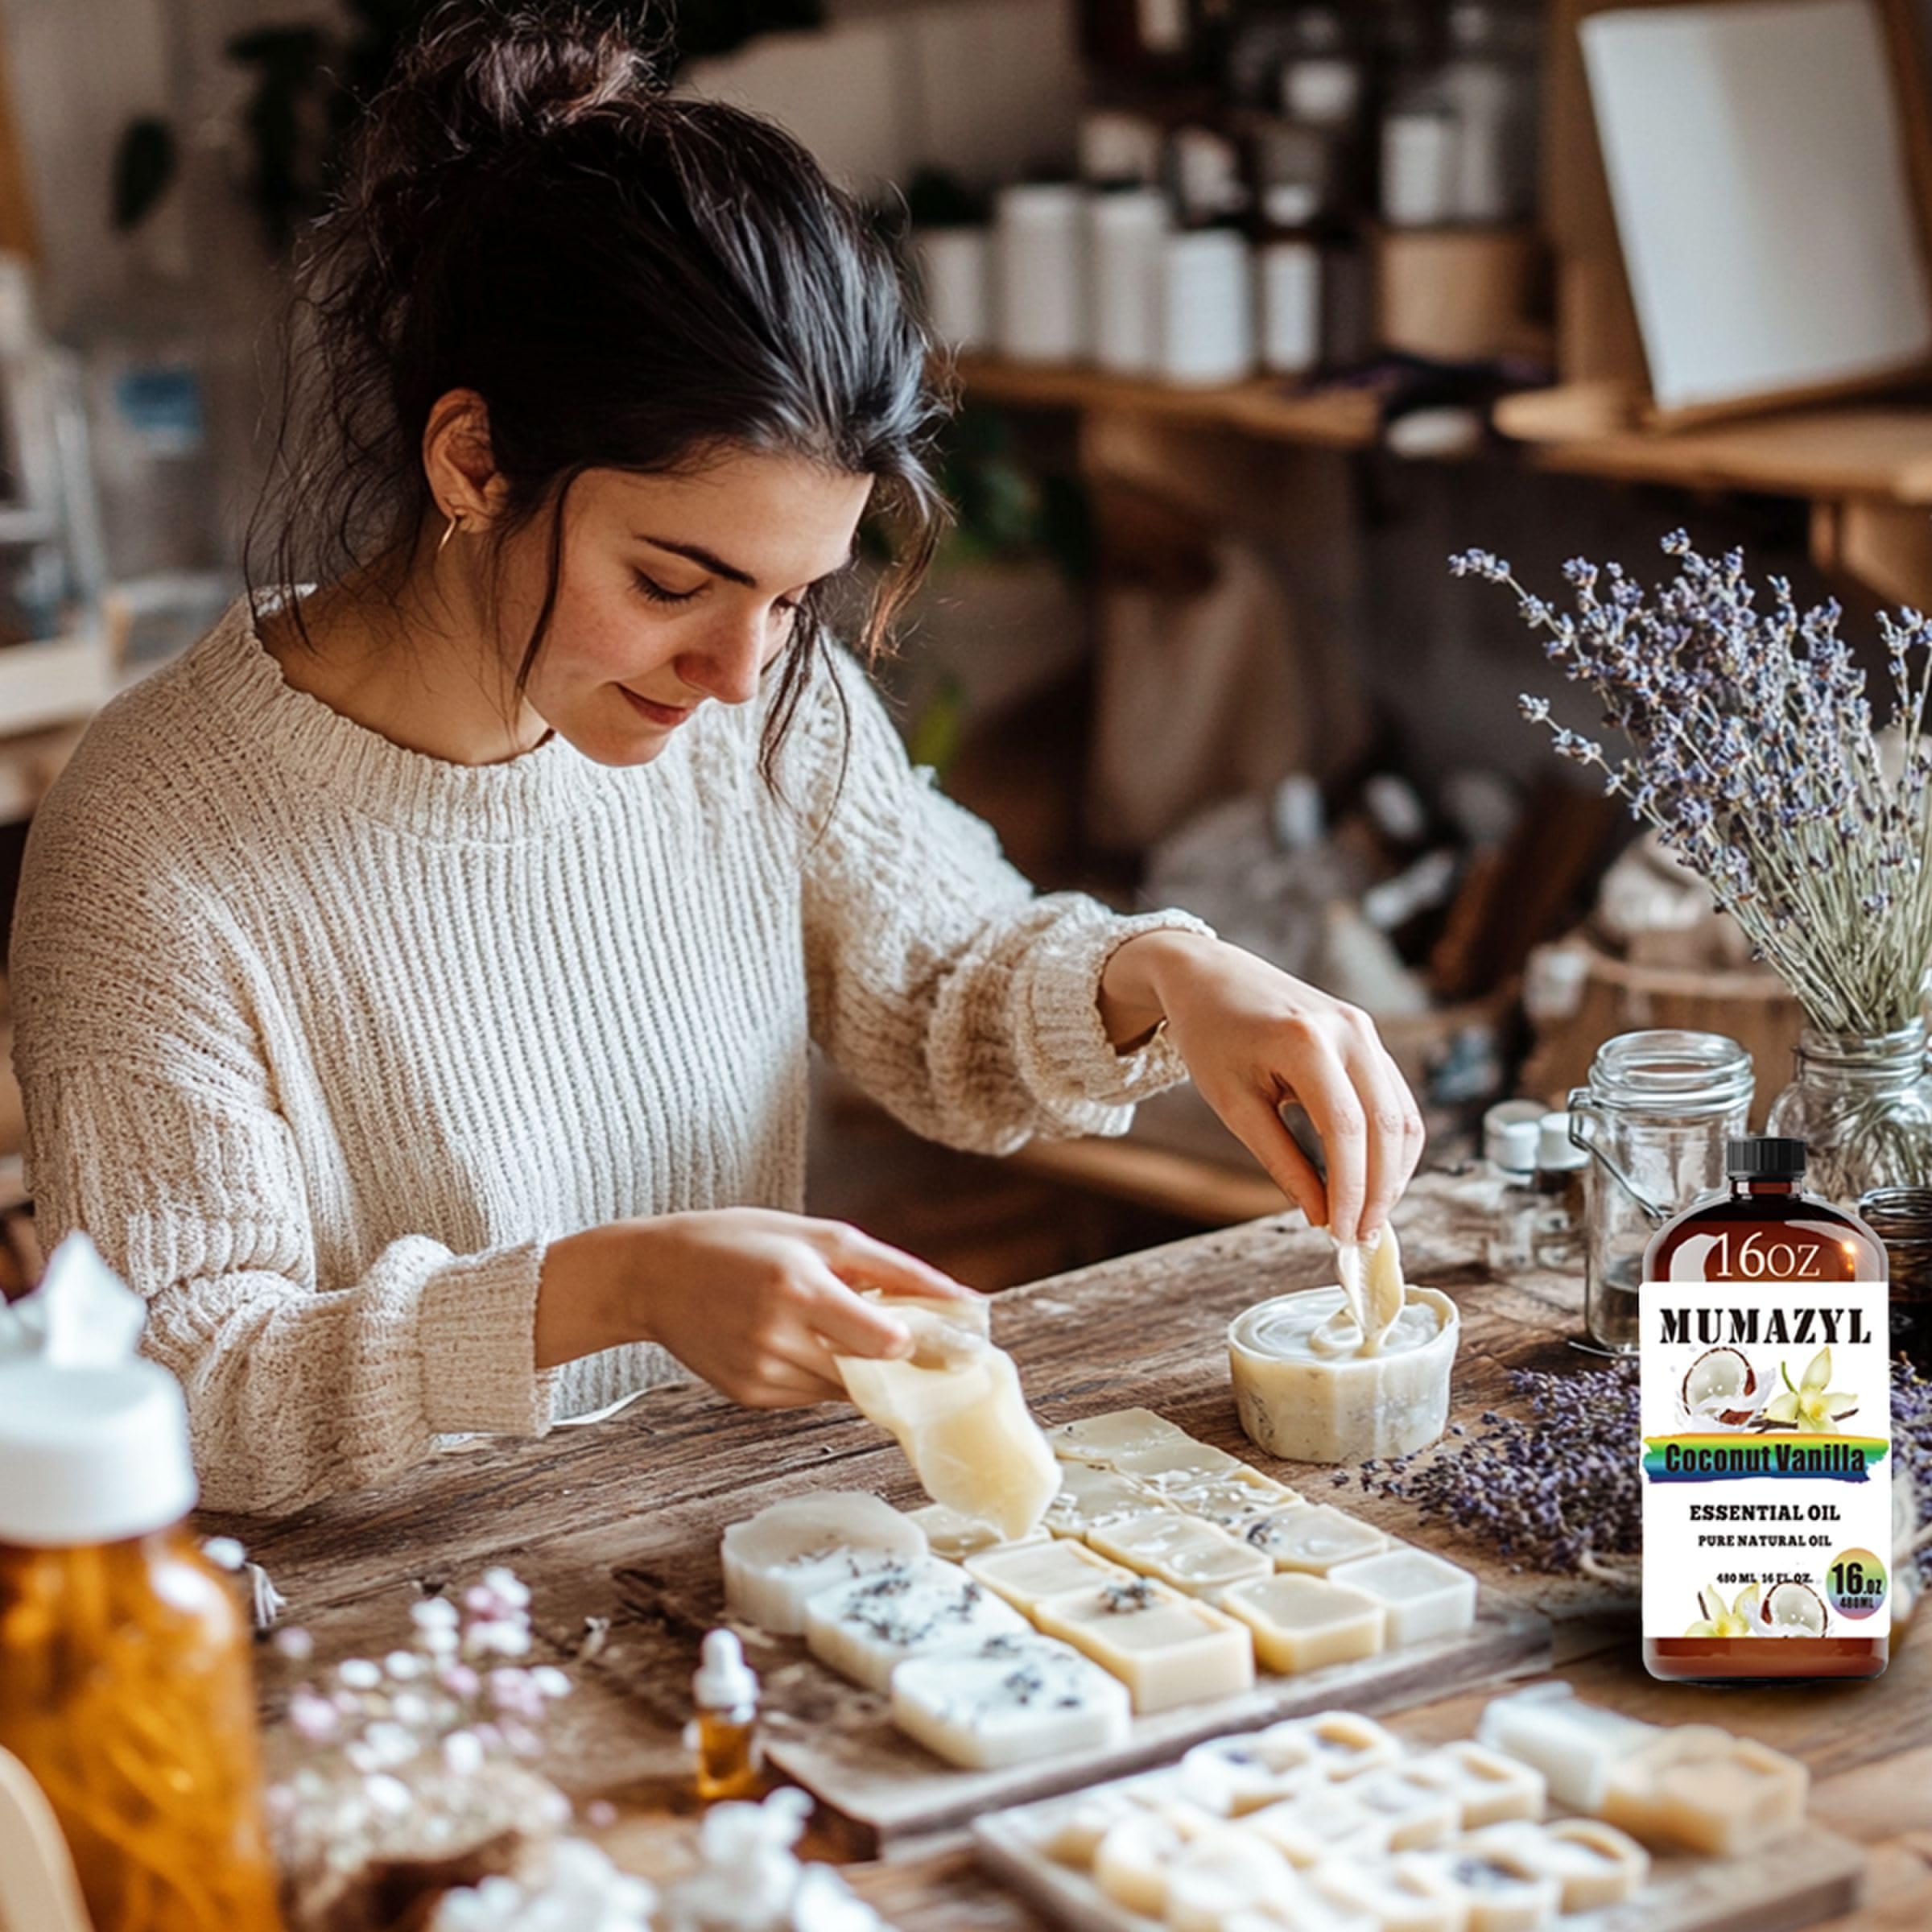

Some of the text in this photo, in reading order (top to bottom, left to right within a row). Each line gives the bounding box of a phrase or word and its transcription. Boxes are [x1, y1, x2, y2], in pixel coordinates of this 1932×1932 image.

[1659, 1308, 1871, 1344] MUMAZYL
[1665, 1443, 1865, 1472] Coconut Vanilla
[1690, 1505, 1840, 1521] ESSENTIAL OIL
[1699, 1535, 1831, 1547] PURE NATURAL OIL
[1716, 1573, 1737, 1583] 480
[1740, 1573, 1757, 1583] ML
[1762, 1573, 1775, 1583] 16
[1839, 1596, 1874, 1609] 480ML
